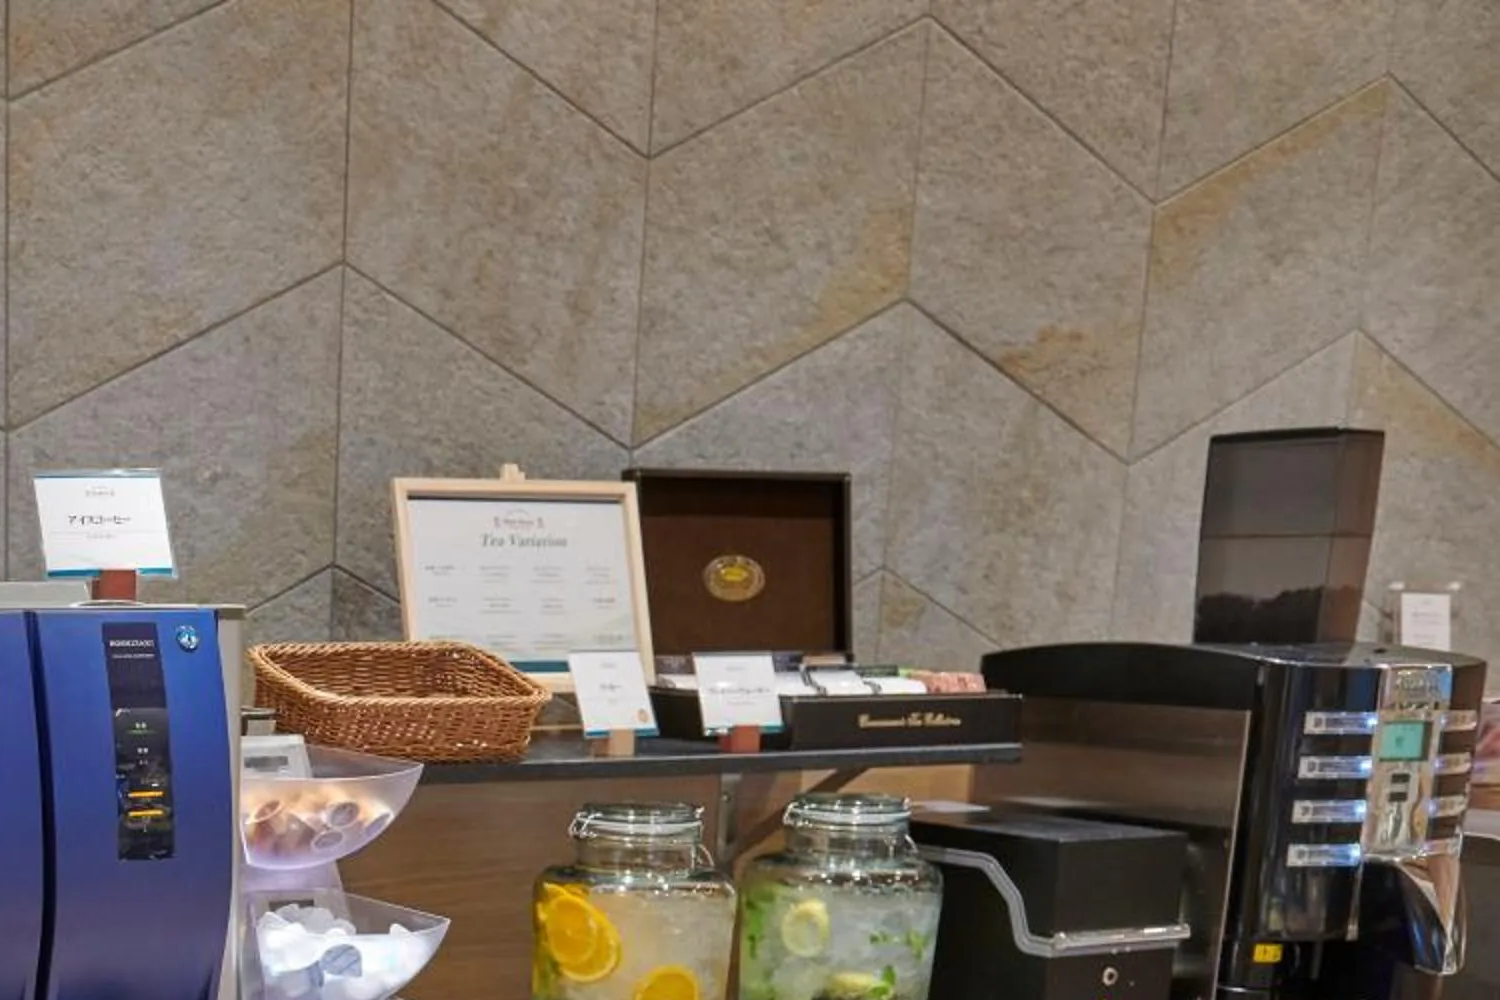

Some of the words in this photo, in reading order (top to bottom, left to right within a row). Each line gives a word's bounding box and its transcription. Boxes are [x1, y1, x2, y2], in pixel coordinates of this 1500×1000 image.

[67, 514, 132, 526] アイスコーヒー
